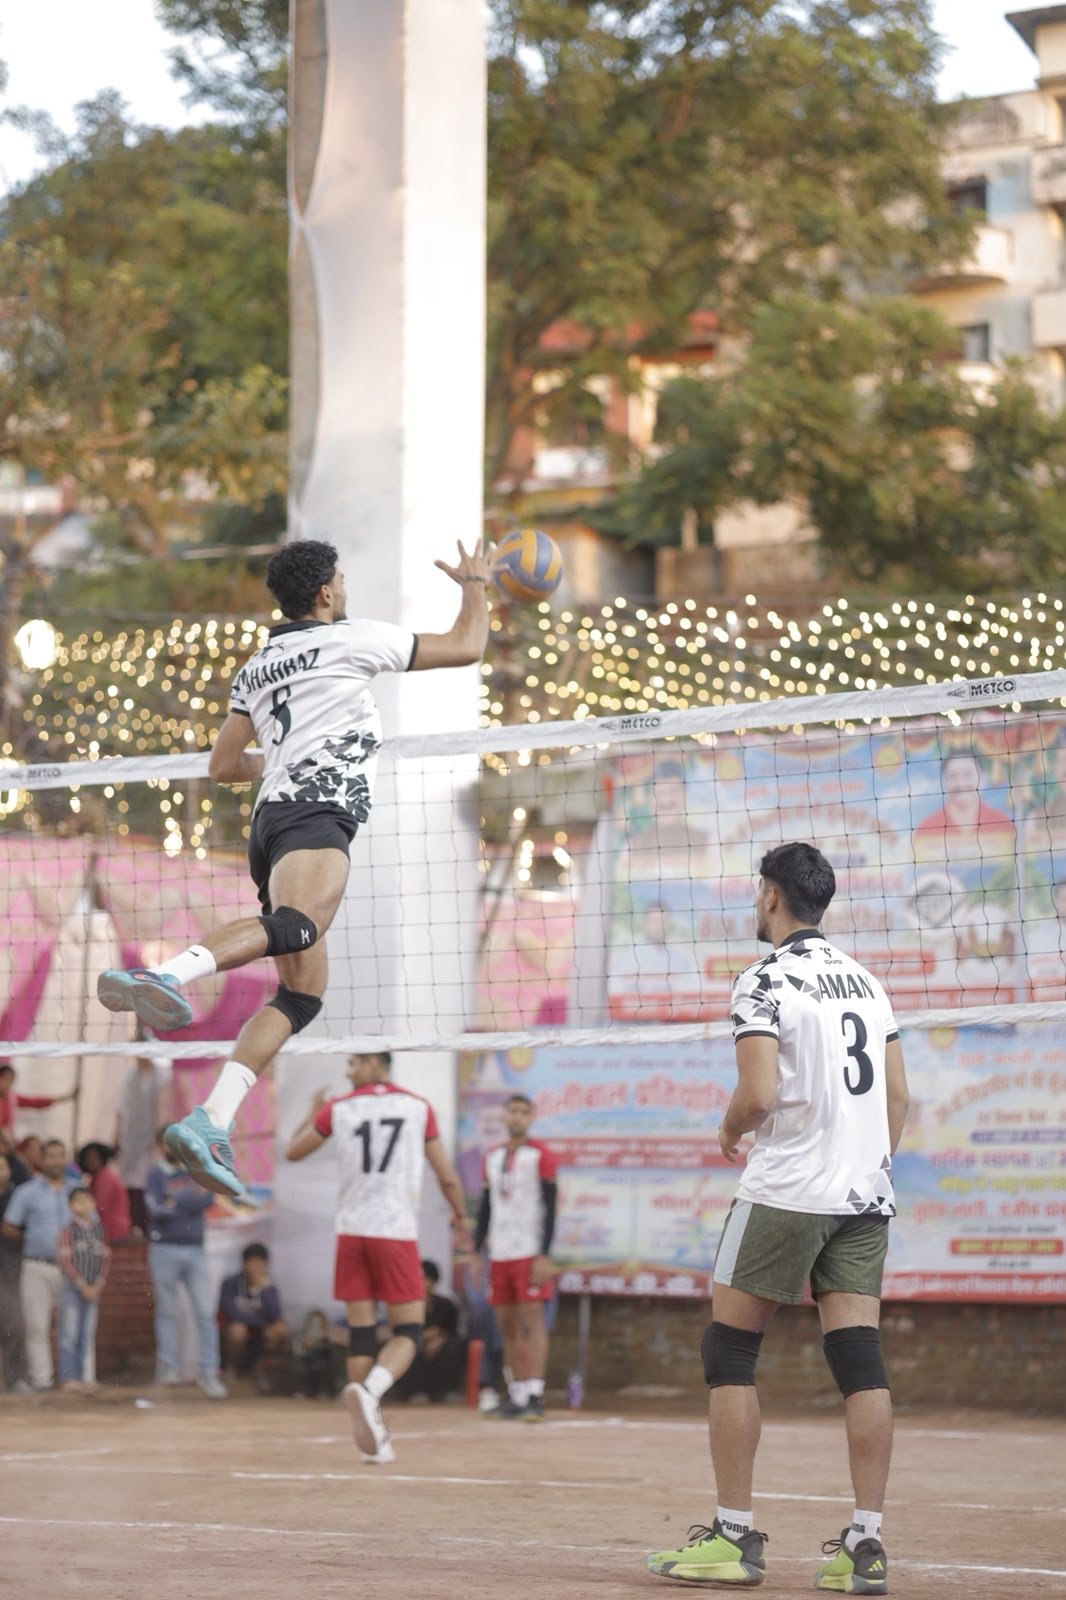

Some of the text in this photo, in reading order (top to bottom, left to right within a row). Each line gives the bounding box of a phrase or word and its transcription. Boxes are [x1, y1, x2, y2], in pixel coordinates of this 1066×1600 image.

[971, 680, 1014, 697] METCO
[621, 717, 660, 729] METCO
[816, 973, 876, 1000] AMAN
[841, 1011, 874, 1096] 3
[354, 1117, 406, 1174] 17
[721, 1519, 750, 1535] PUMA
